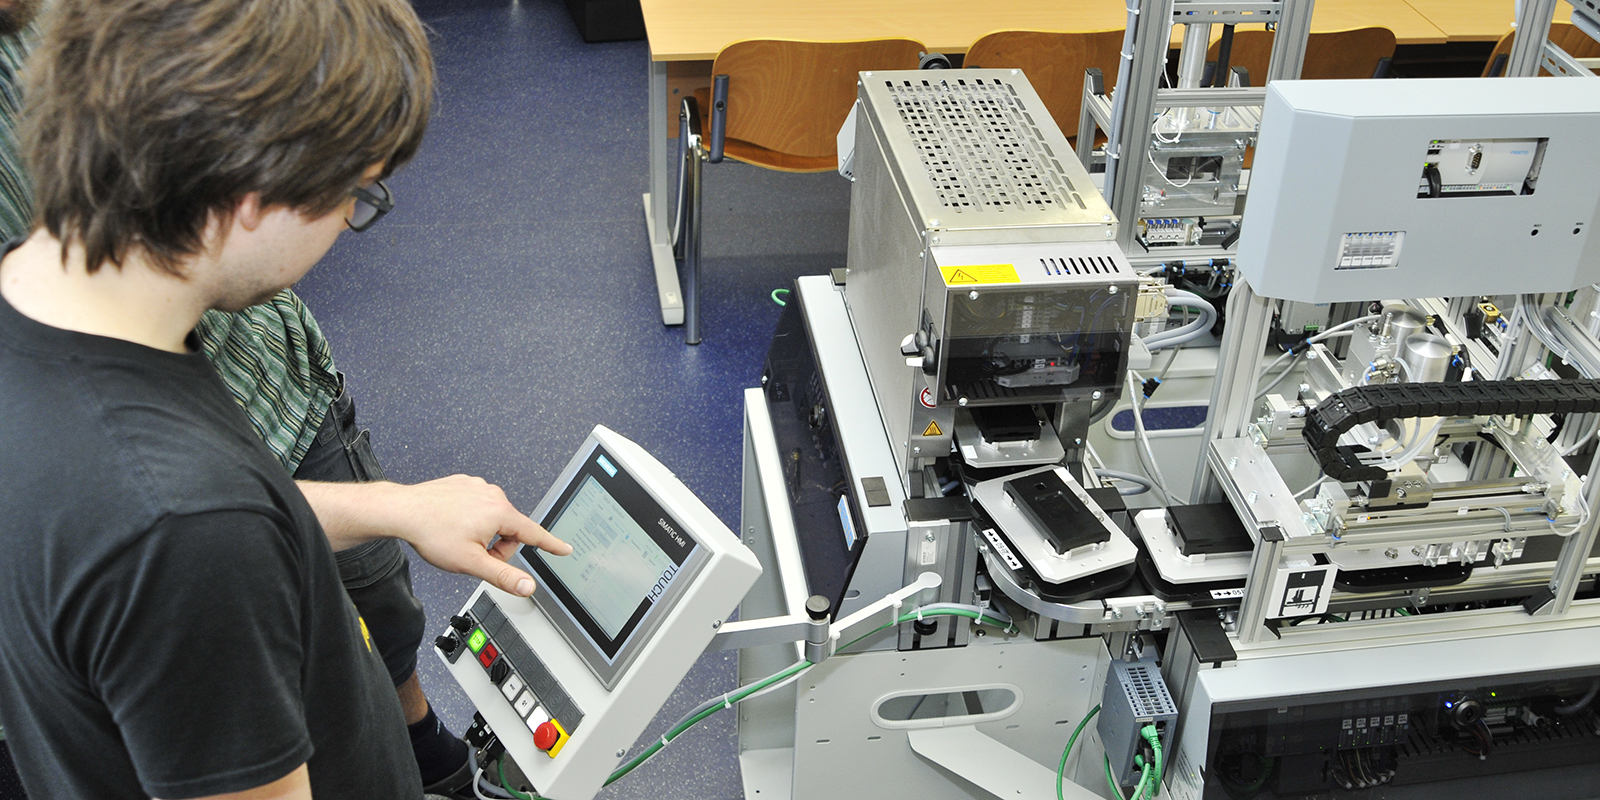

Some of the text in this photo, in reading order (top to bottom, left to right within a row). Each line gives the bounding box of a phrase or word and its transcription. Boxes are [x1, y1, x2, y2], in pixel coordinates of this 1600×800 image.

[658, 518, 678, 539] SIMATIC
[674, 535, 686, 548] HMI
[648, 565, 678, 602] TOUCH
